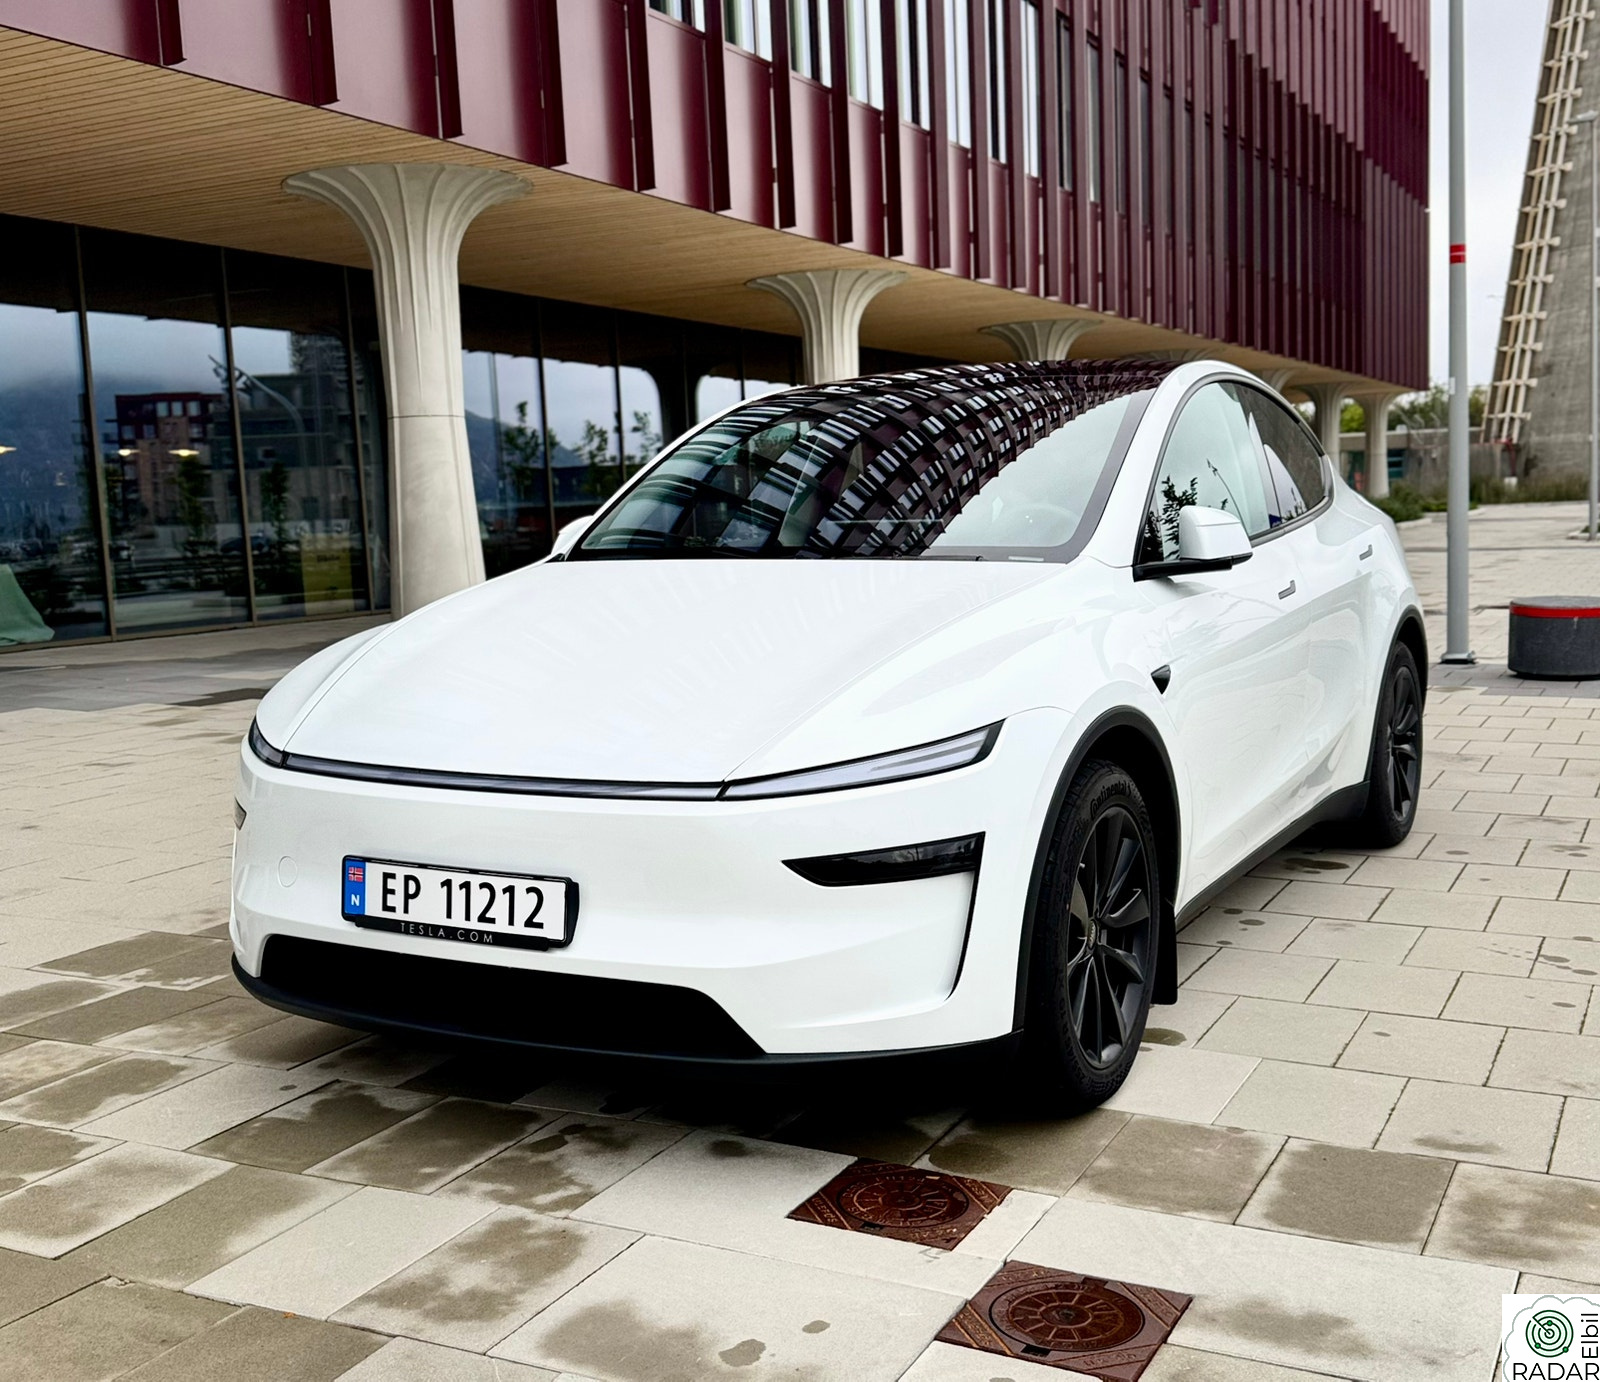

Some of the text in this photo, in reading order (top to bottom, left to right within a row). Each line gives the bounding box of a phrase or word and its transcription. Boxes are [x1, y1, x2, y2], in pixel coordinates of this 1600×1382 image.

[351, 894, 360, 907] N
[382, 872, 544, 929] EP 11212
[400, 922, 493, 944] TESLA.COM
